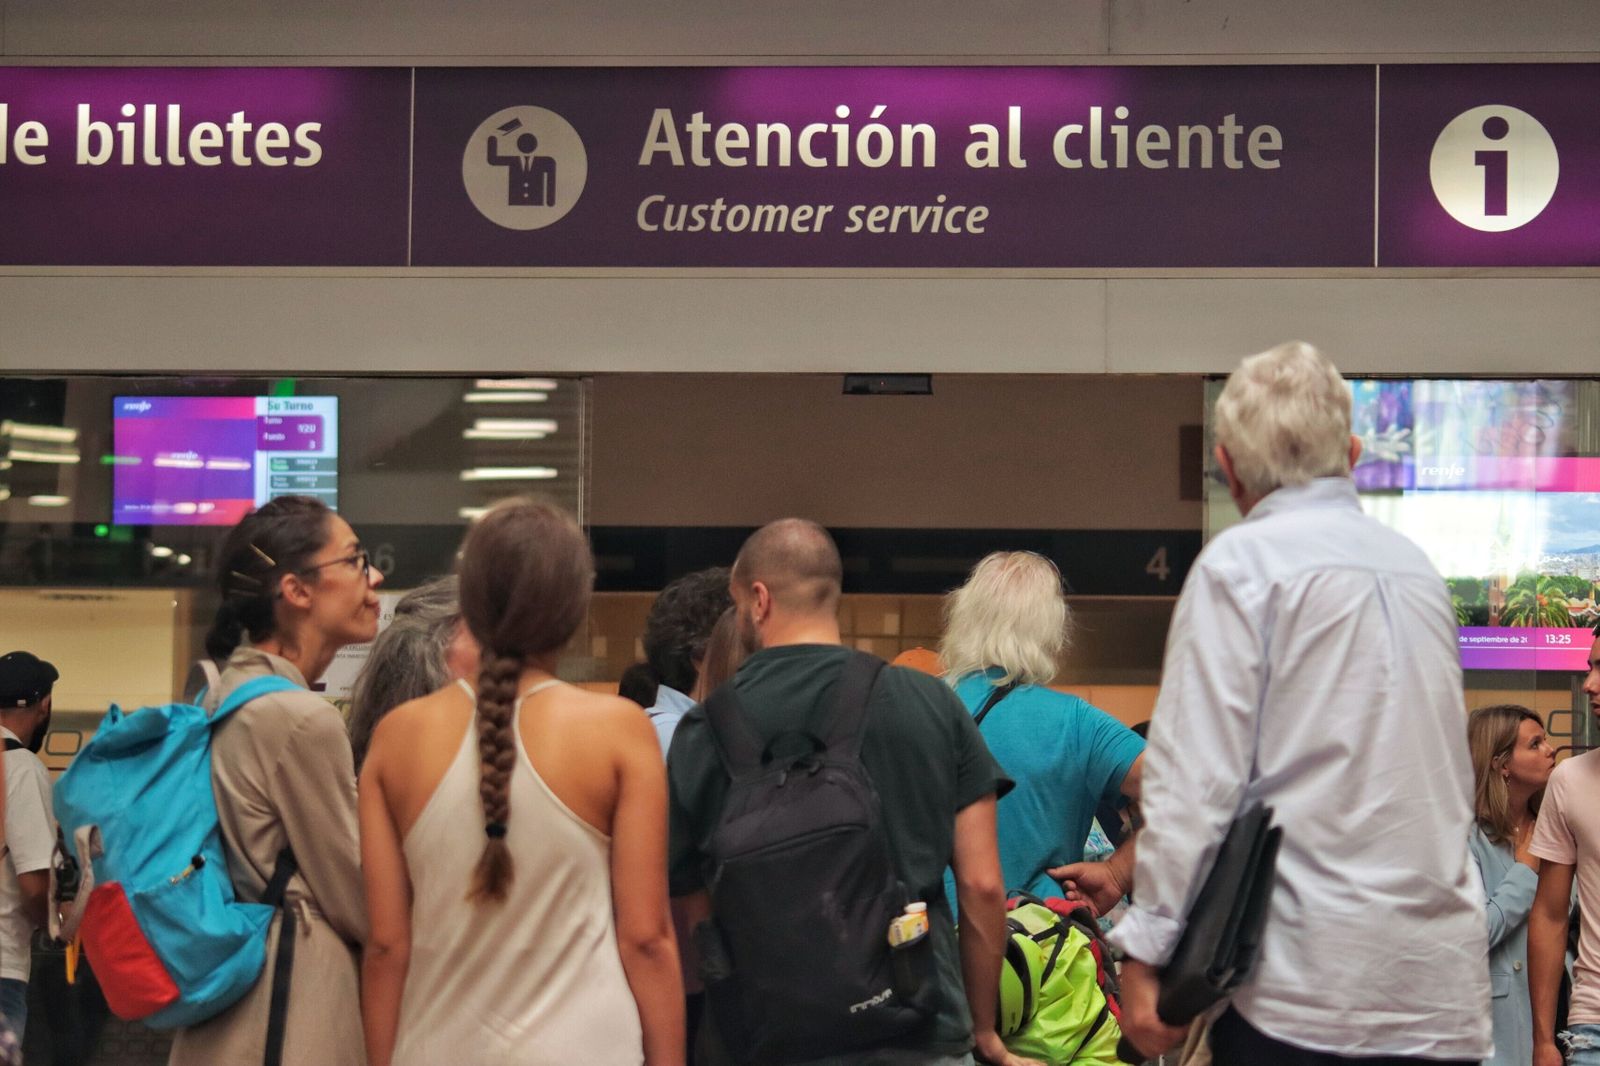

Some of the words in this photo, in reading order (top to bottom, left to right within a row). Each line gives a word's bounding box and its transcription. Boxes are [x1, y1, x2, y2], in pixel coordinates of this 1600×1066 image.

[0, 103, 49, 165] e
[76, 103, 323, 166] billetes
[638, 104, 937, 168] Atención
[964, 105, 1027, 168] al
[1053, 106, 1283, 169] cliente
[637, 194, 834, 232] Customer
[844, 194, 990, 234] service
[1421, 462, 1465, 480] renfe
[1145, 547, 1169, 580] 4
[1469, 636, 1509, 644] septiembre
[1545, 634, 1572, 645] 13:25
